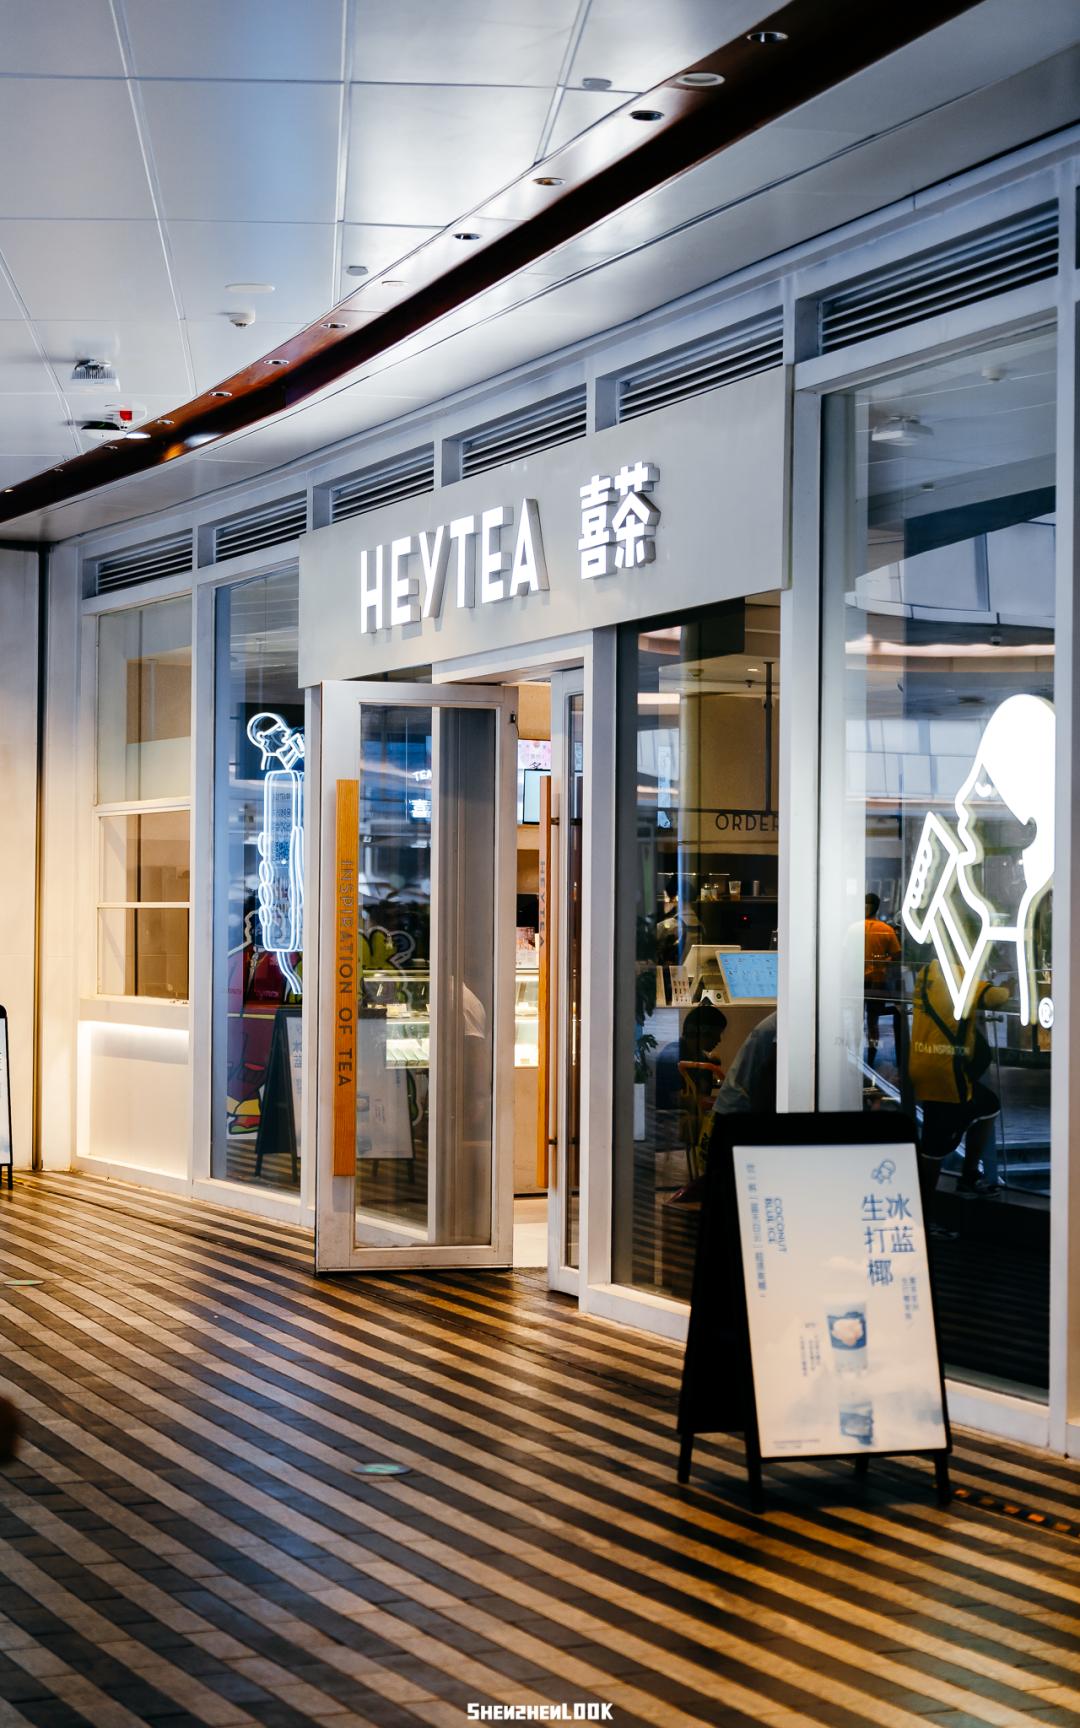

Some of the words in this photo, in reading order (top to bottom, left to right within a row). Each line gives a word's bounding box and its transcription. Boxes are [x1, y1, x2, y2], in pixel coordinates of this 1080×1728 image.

[578, 461, 661, 580] 喜茶
[360, 498, 549, 634] HEYTEA
[338, 860, 353, 994] INSPIRATION
[338, 1007, 353, 1036] OF
[337, 1049, 353, 1087] TEA
[774, 1197, 787, 1253] COCONUT
